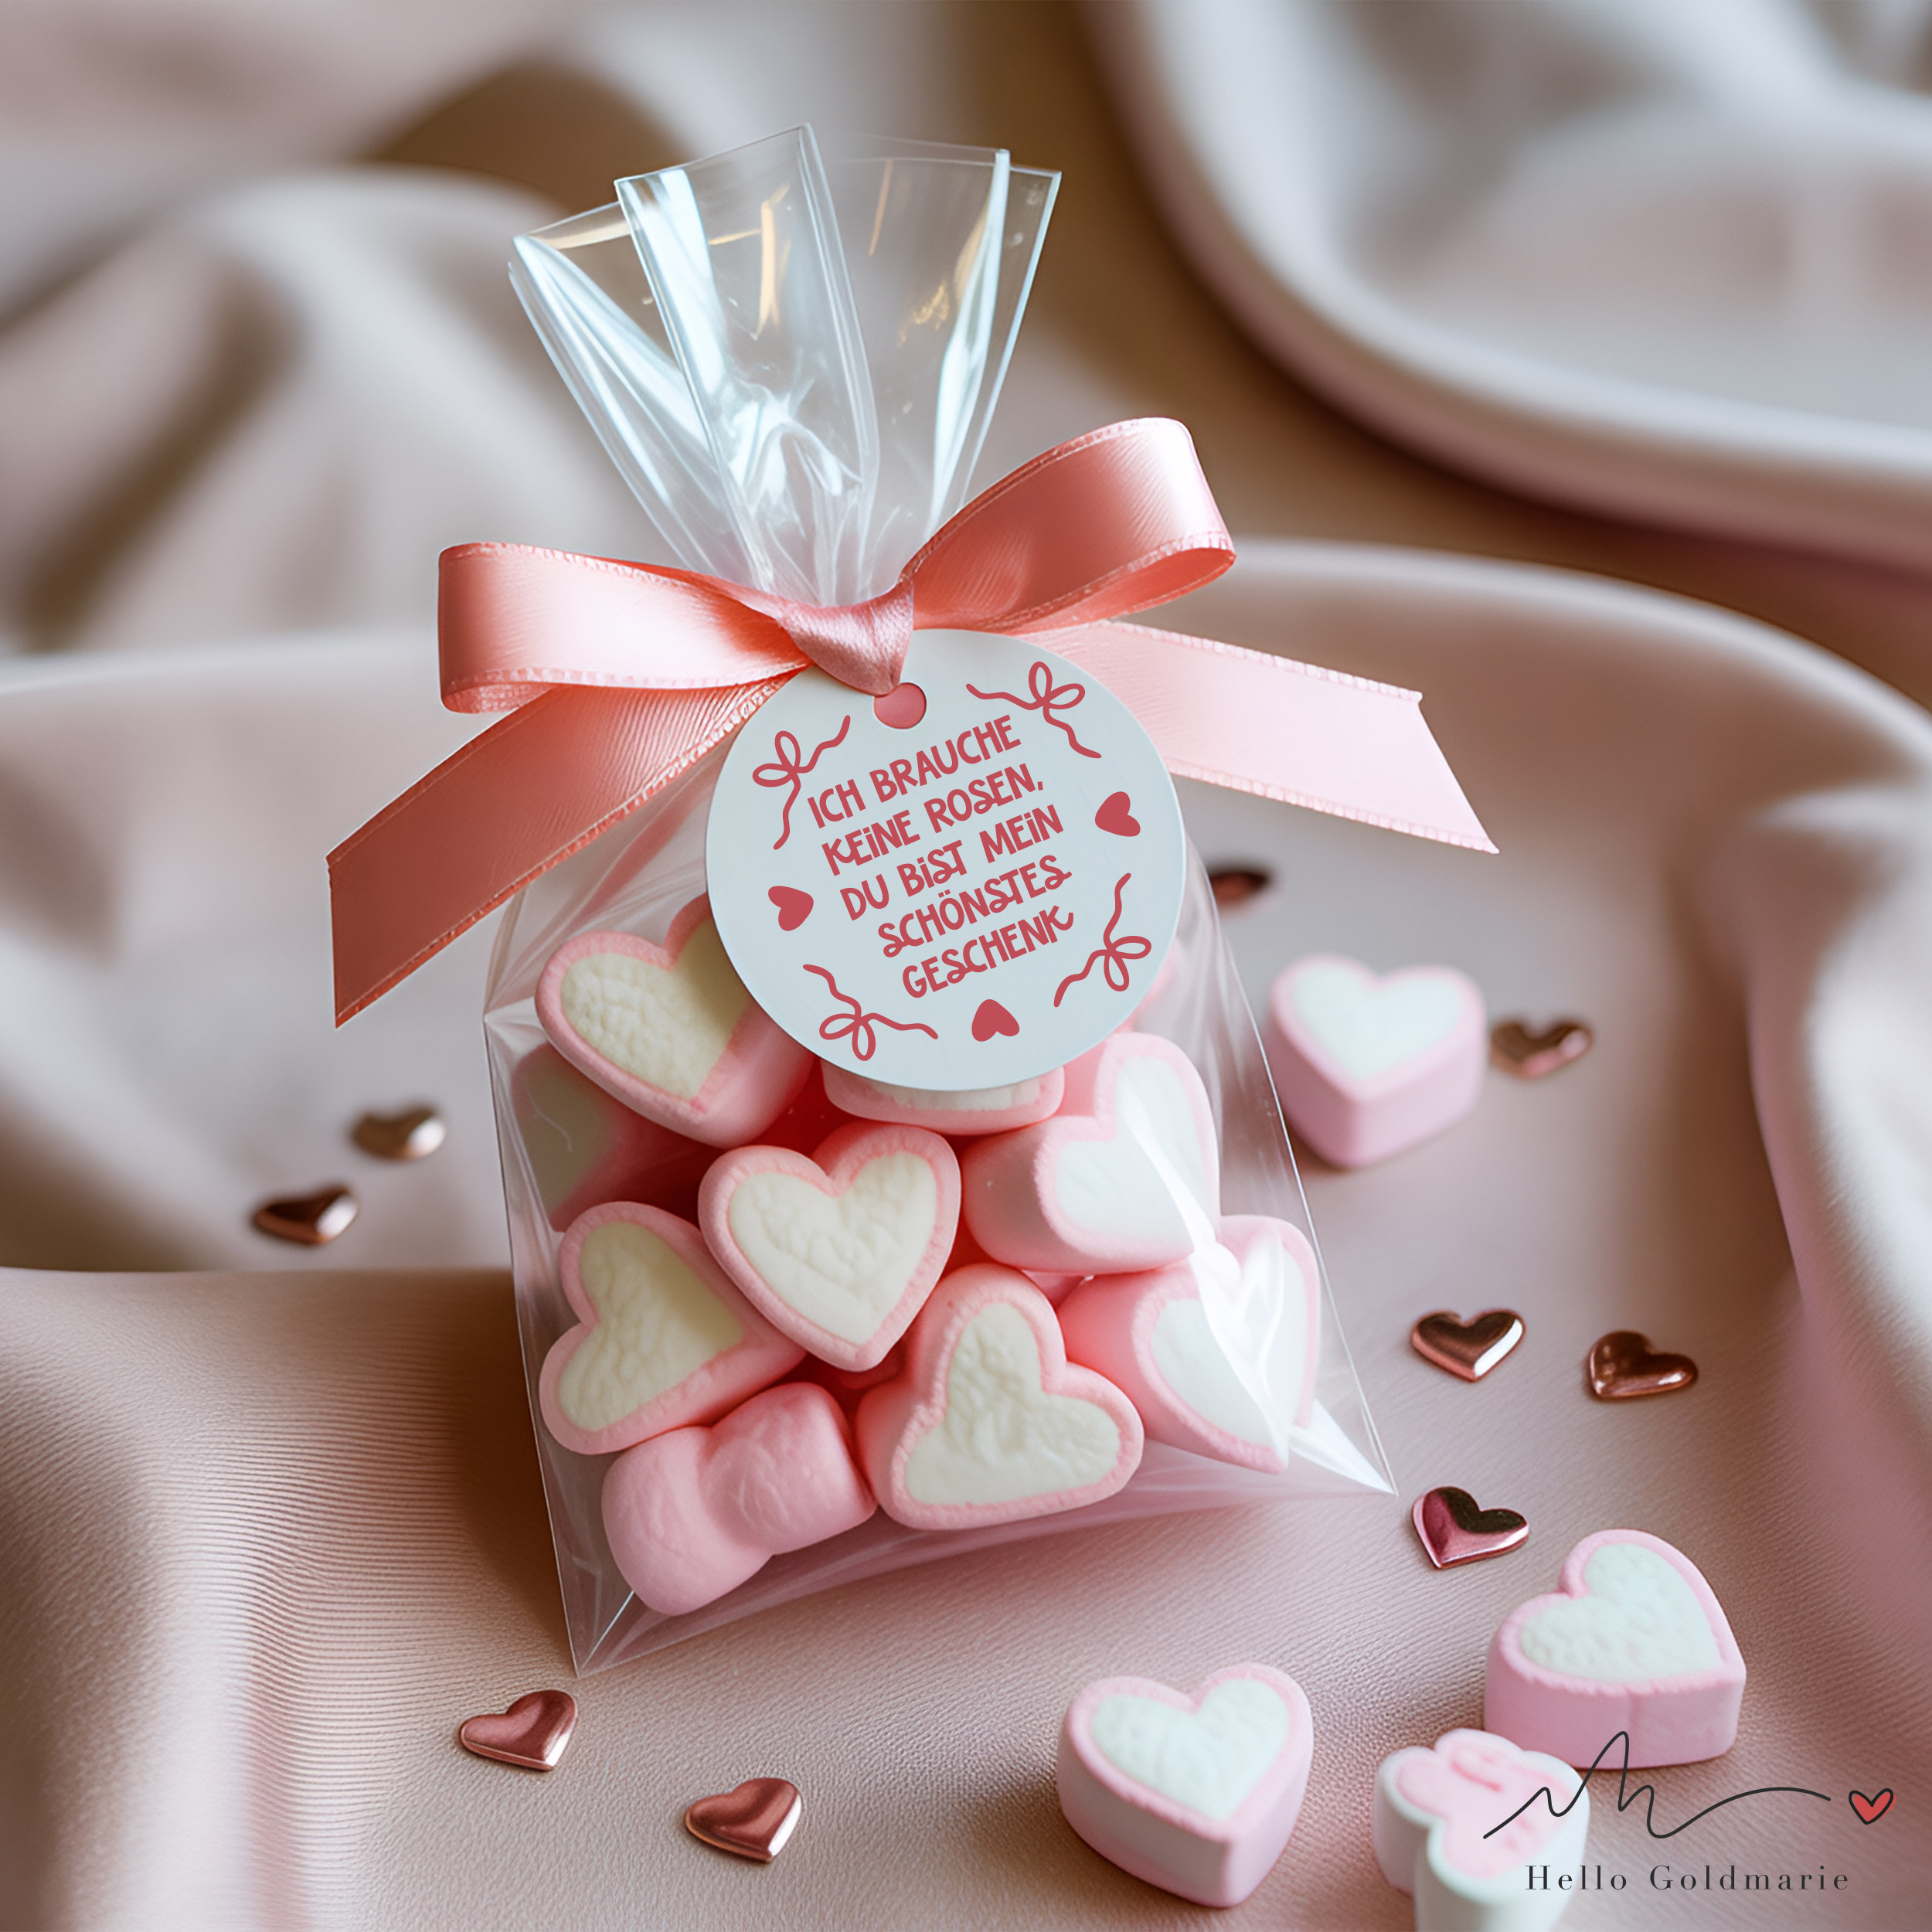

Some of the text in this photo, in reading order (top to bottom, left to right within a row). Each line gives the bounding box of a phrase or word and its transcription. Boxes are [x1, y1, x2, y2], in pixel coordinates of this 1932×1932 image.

[808, 715, 1021, 828] ICH BRAUCHE
[923, 764, 1043, 833] ROSEN,
[840, 874, 889, 920] DU
[879, 855, 1072, 957] SCHÖNSTES
[903, 906, 1073, 998] GESCHENK
